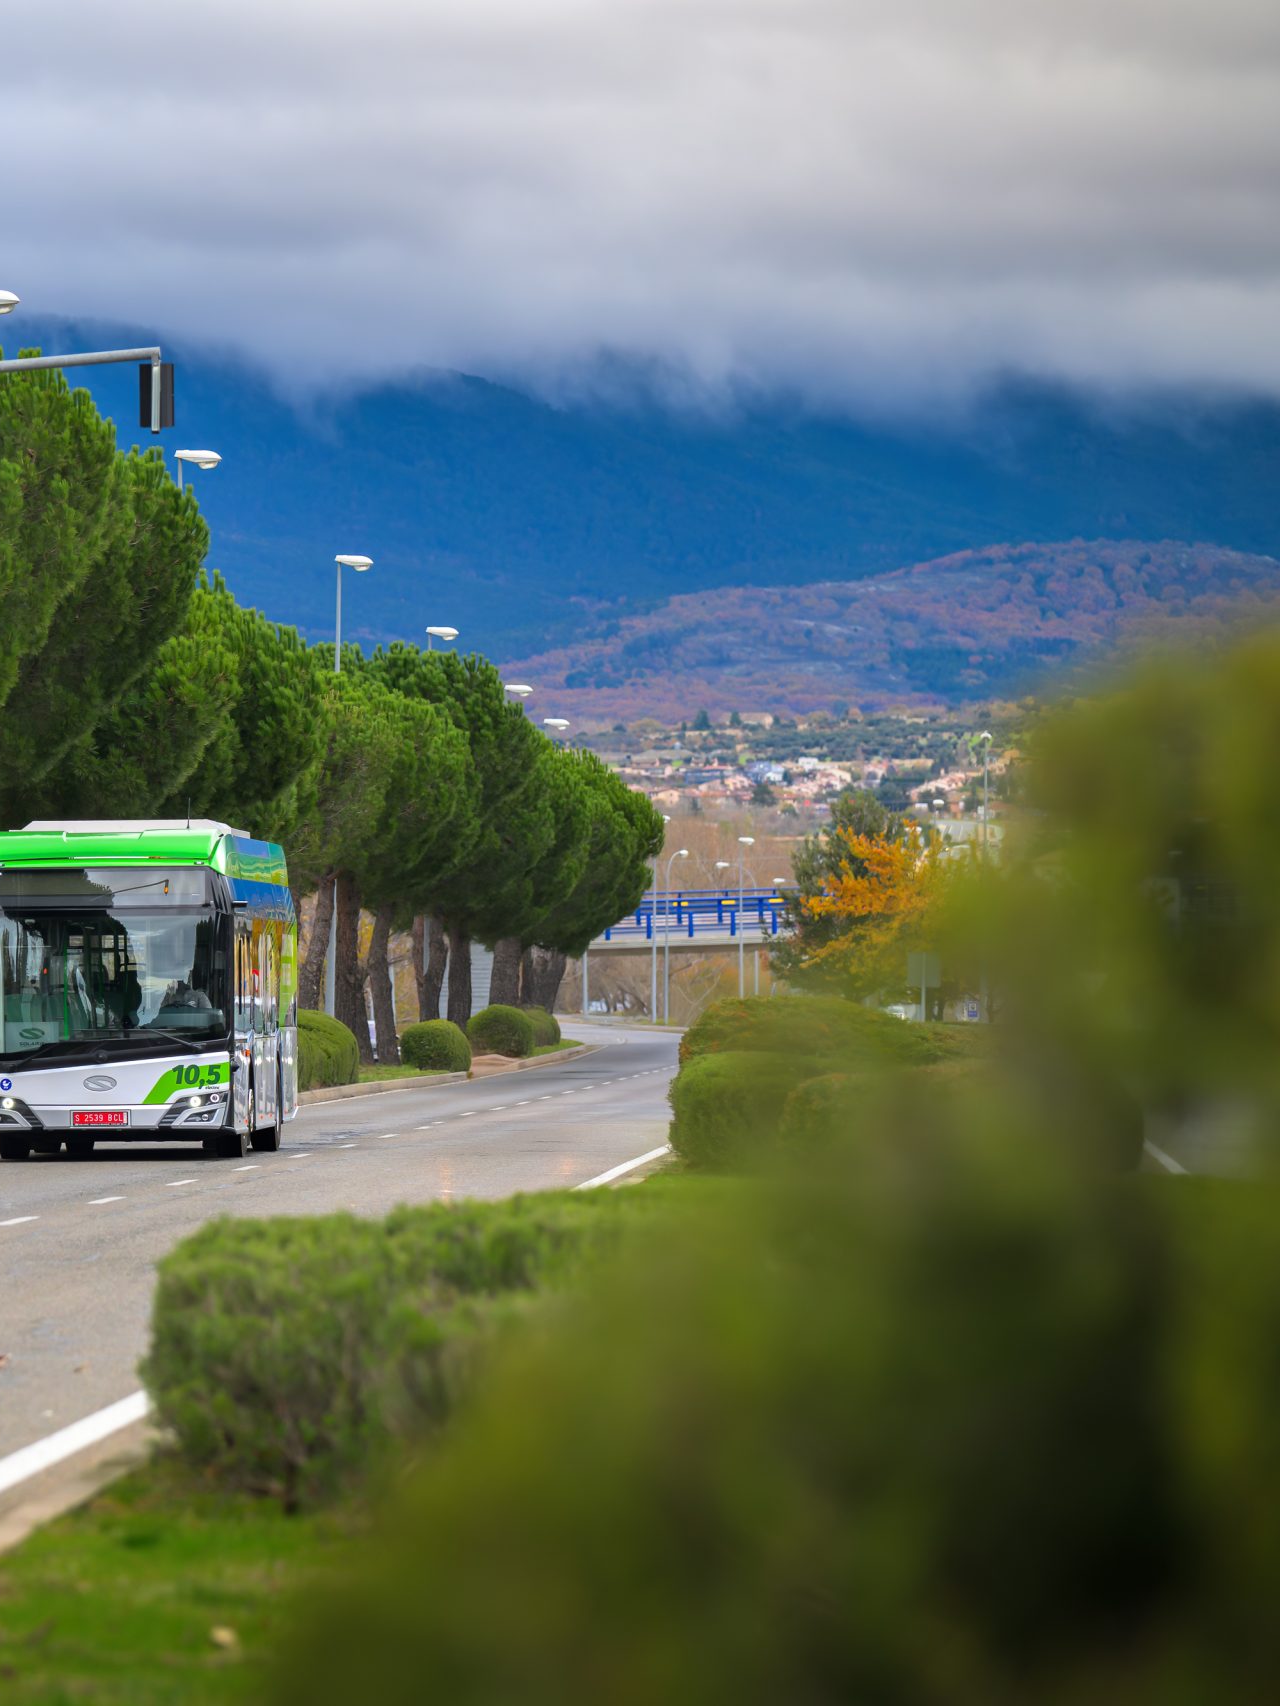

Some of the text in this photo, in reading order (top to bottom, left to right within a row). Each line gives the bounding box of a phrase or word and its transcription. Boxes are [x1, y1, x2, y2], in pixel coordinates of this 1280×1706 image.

[171, 1064, 221, 1090] 10,5
[75, 1114, 123, 1122] S 2539 BCL
